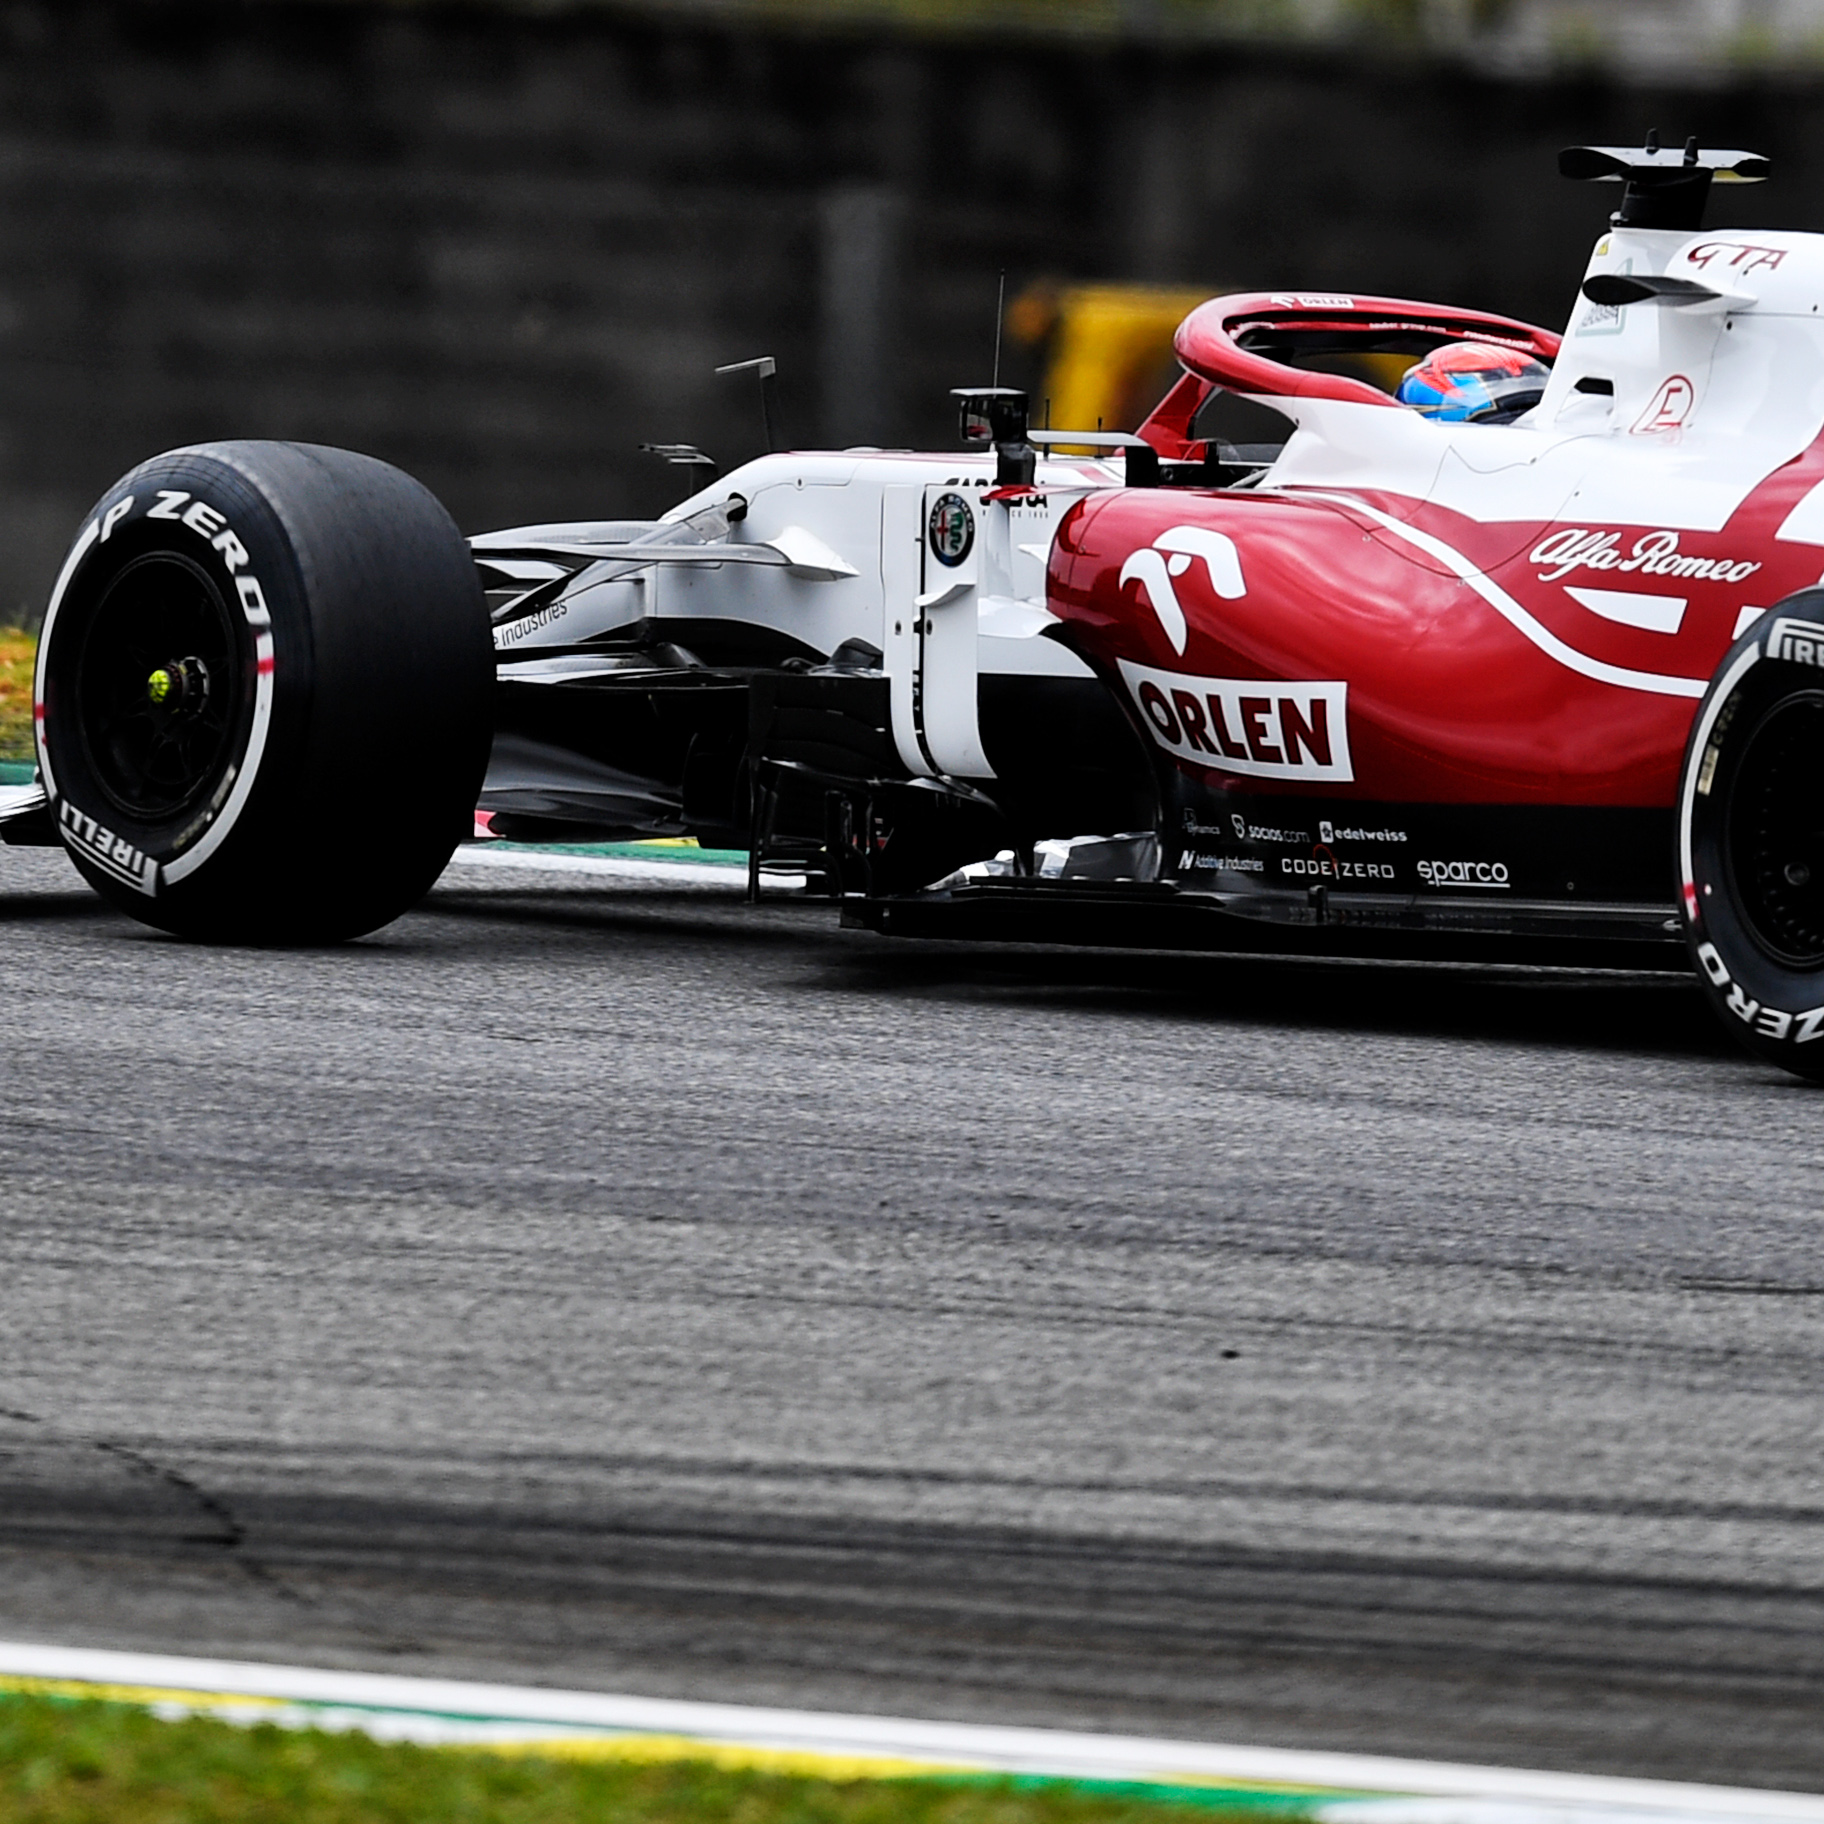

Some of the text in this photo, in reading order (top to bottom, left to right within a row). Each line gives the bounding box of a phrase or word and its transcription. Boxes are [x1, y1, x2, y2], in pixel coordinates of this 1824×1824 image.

[1687, 242, 1788, 270] GTA
[100, 490, 271, 625] P ZERO
[1529, 528, 1762, 583] Alfa Romeo
[1138, 680, 1333, 766] ORLEN
[59, 798, 158, 898] PIRELLI
[1248, 825, 1311, 843] socios.com
[1334, 828, 1408, 842] edelweiss
[1417, 860, 1509, 886] sparco
